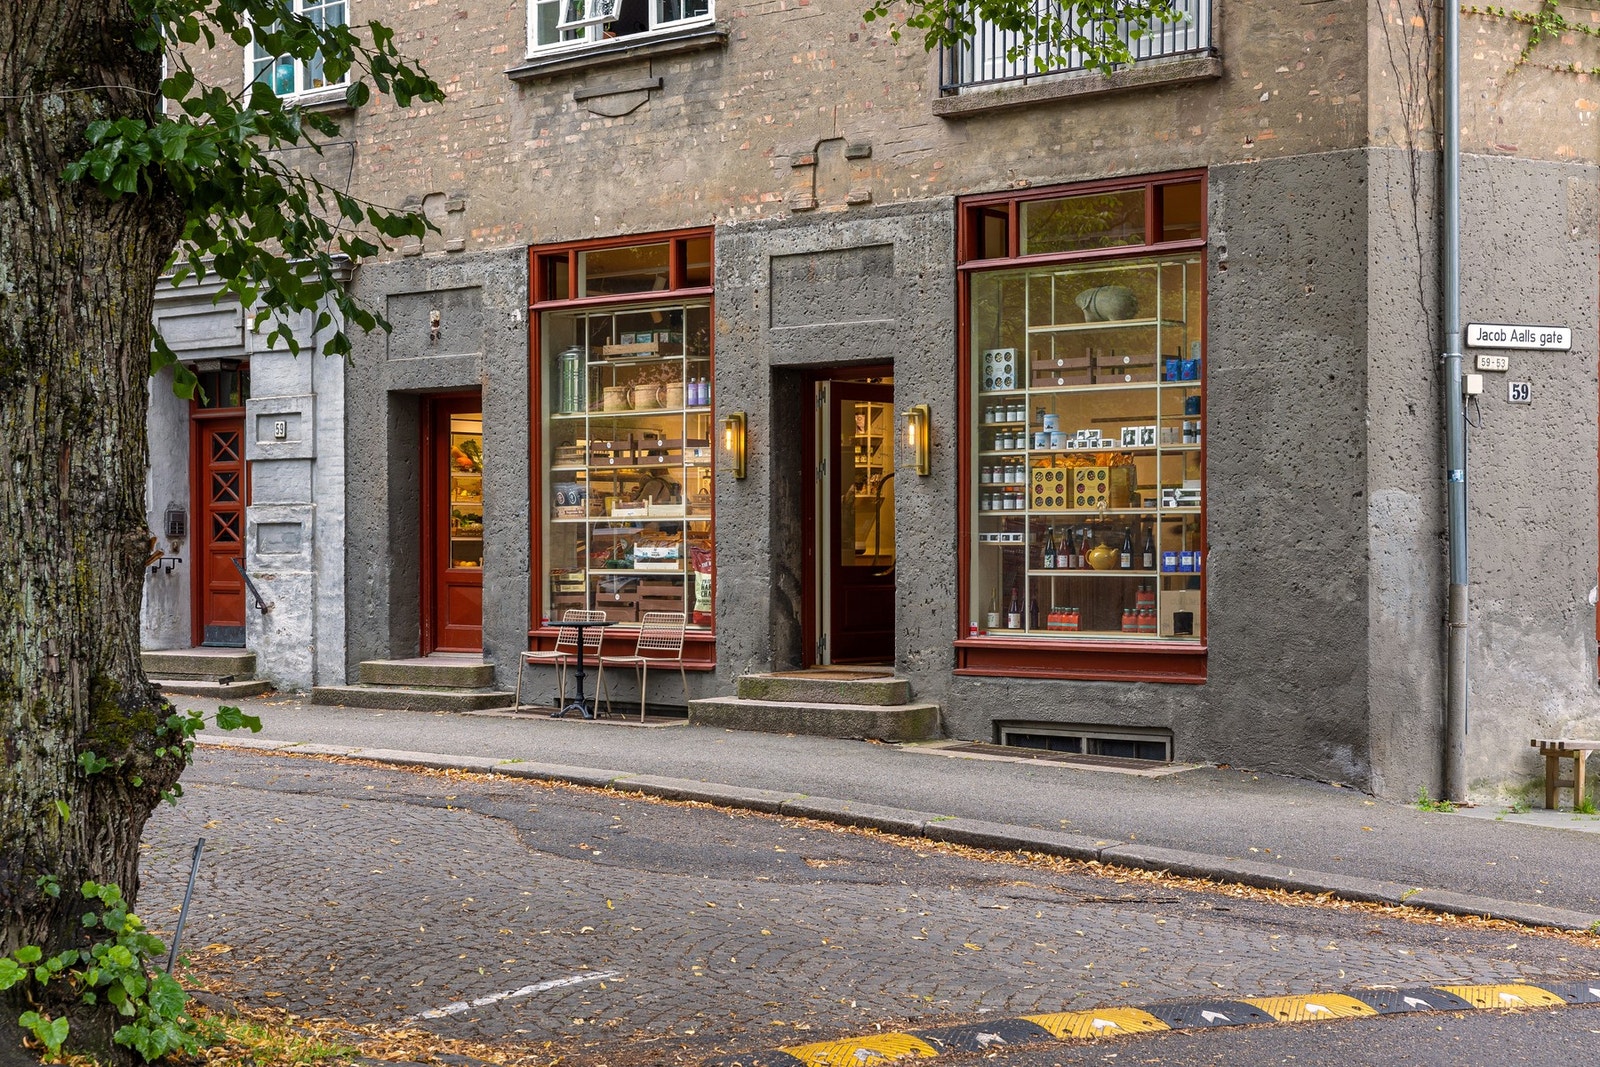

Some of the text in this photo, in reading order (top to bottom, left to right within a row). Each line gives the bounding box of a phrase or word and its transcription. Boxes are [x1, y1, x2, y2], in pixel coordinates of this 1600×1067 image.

[1476, 328, 1563, 346] Jacob Aalls gate
[1512, 384, 1529, 400] 59
[275, 423, 284, 435] 59
